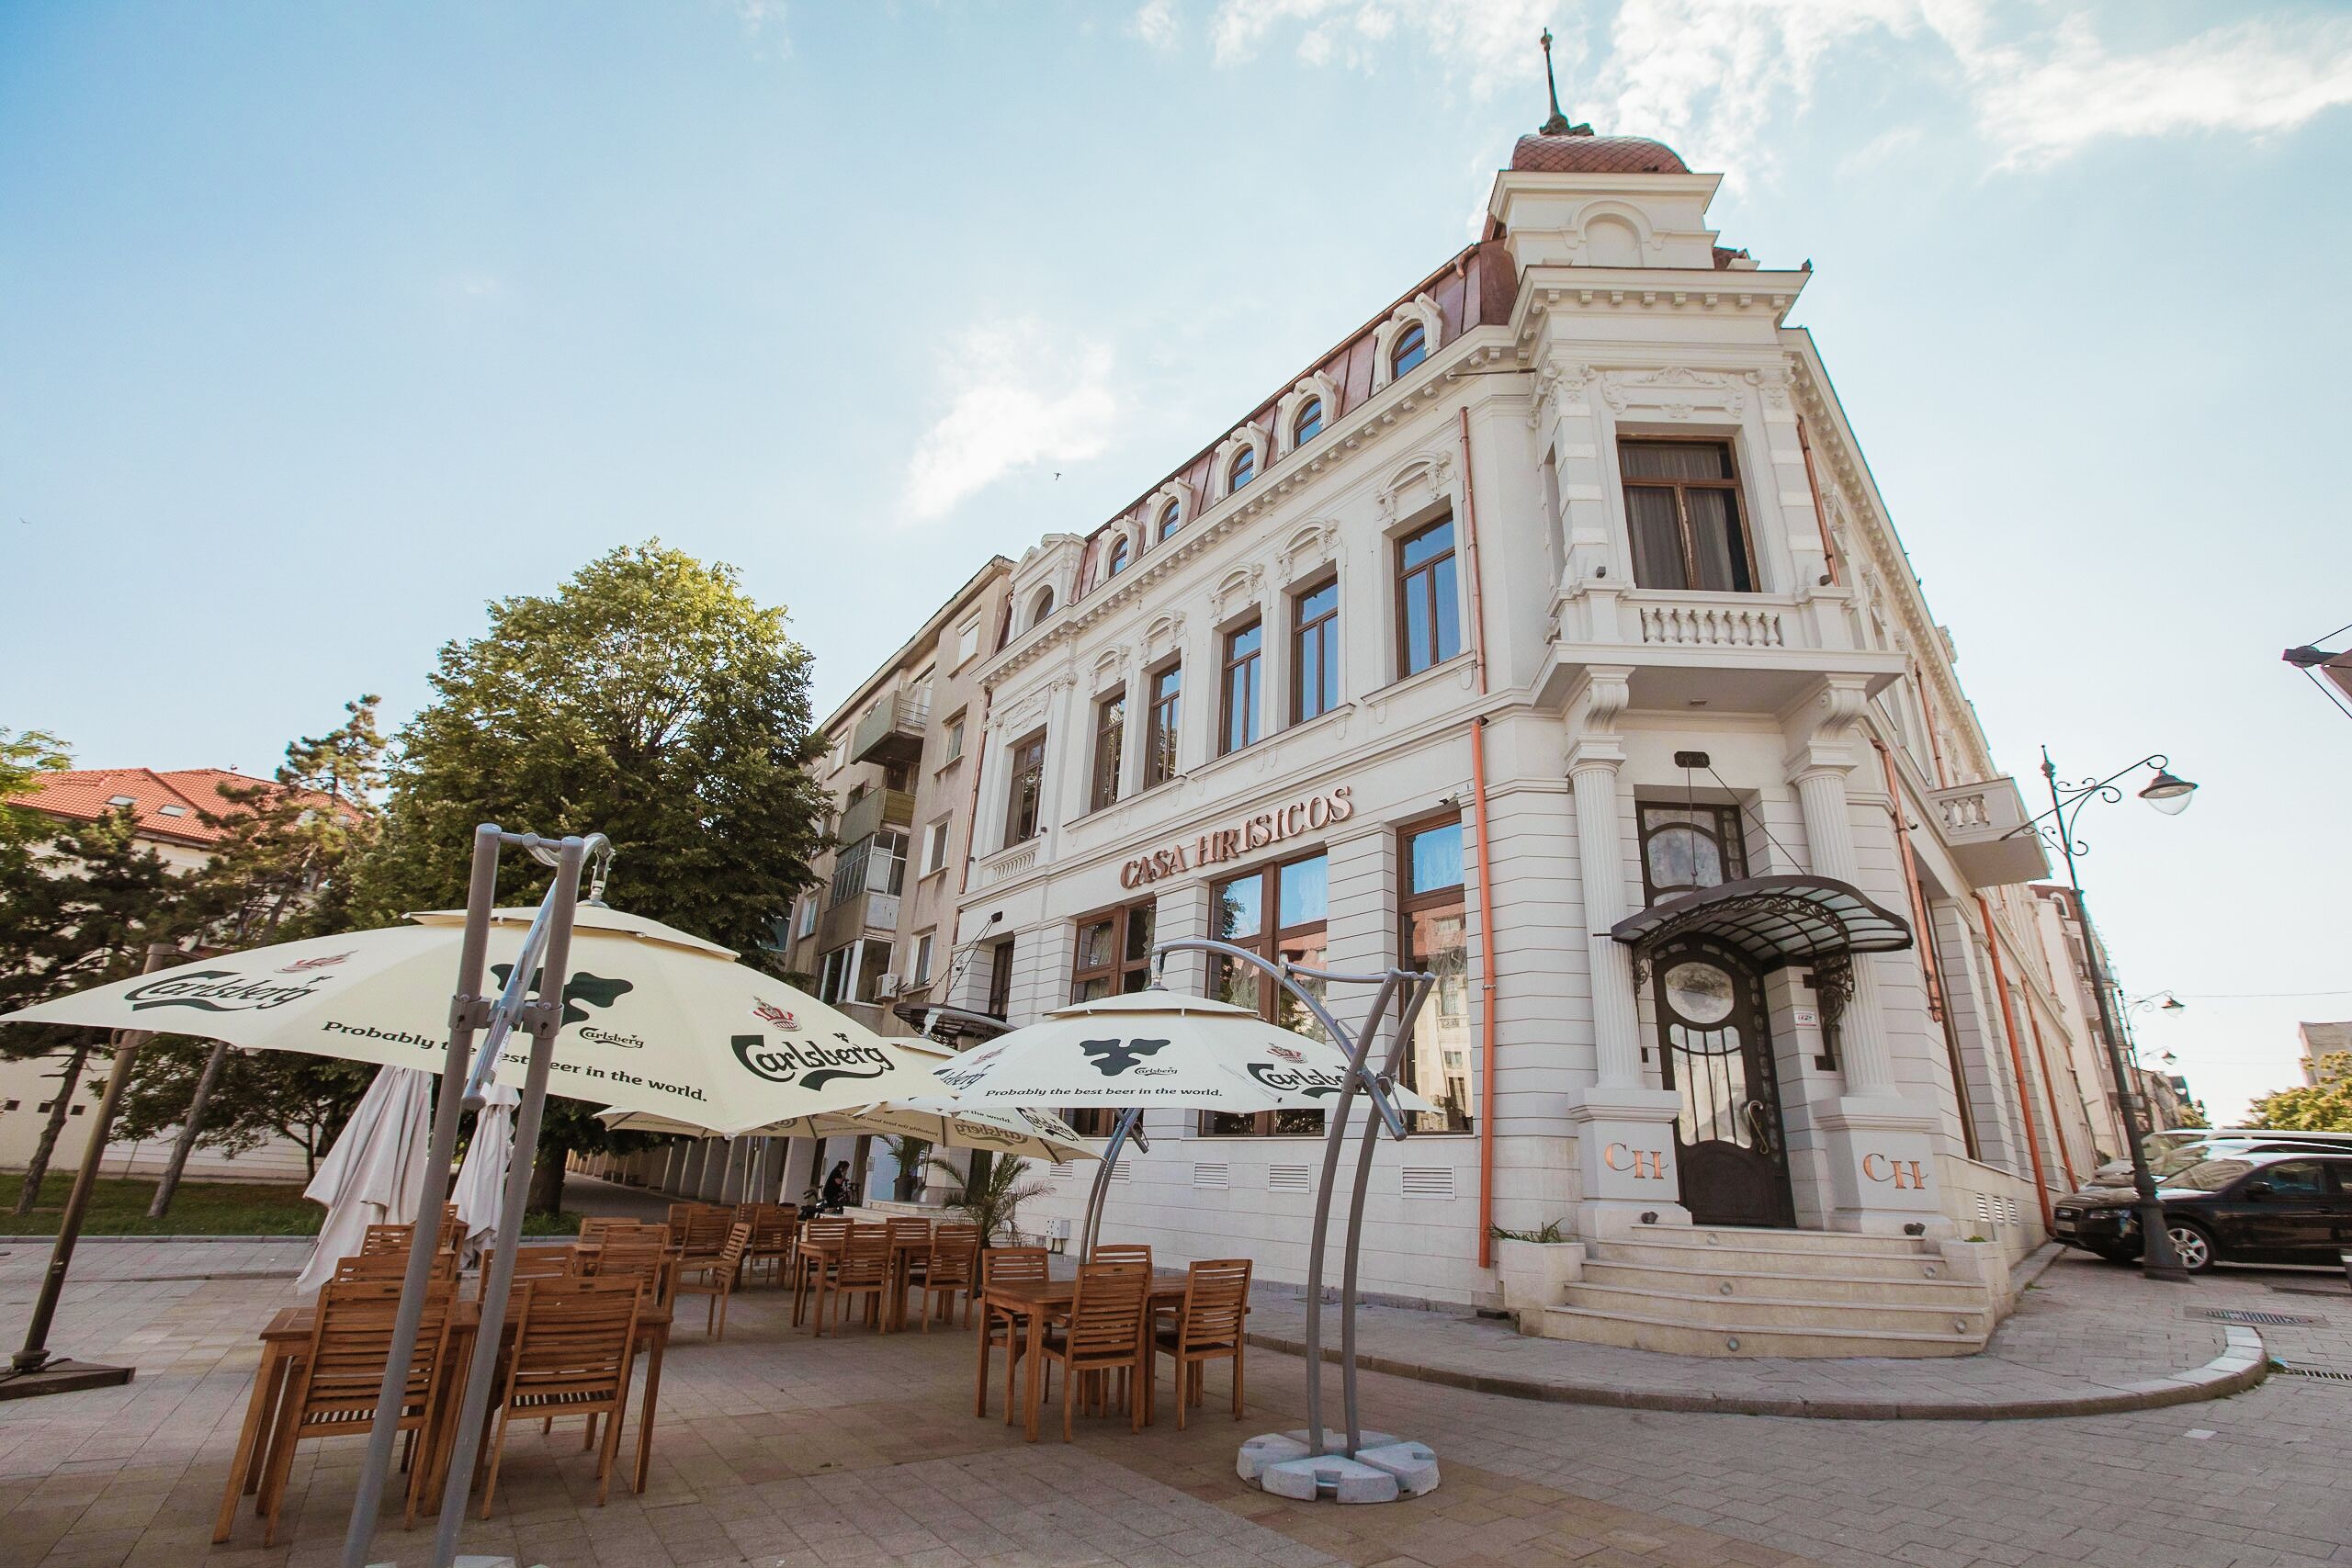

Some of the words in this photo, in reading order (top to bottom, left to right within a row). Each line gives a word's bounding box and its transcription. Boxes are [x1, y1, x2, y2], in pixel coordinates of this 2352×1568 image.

[1120, 844, 1188, 889] CASA
[1196, 785, 1354, 866] HRISICOS
[124, 970, 334, 1012] Carlsberg
[579, 1026, 645, 1049] Carlsberg
[321, 1021, 435, 1050] Probably
[441, 1041, 477, 1056] te
[503, 1053, 530, 1065] est
[550, 1062, 582, 1074] eer
[586, 1066, 605, 1078] in
[611, 1070, 643, 1086] the
[648, 1079, 707, 1102] world.
[731, 1032, 896, 1092] Carlsberg
[1134, 1066, 1178, 1077] Carlsberg
[985, 1088, 1047, 1097] Probably
[1049, 1088, 1071, 1096] the
[1074, 1088, 1102, 1096] best
[1105, 1088, 1136, 1096] beer
[1139, 1088, 1151, 1096] in
[1155, 1088, 1177, 1096] the
[1181, 1089, 1224, 1097] world.
[1604, 1142, 1668, 1180] CH
[1863, 1153, 1928, 1190] CH
